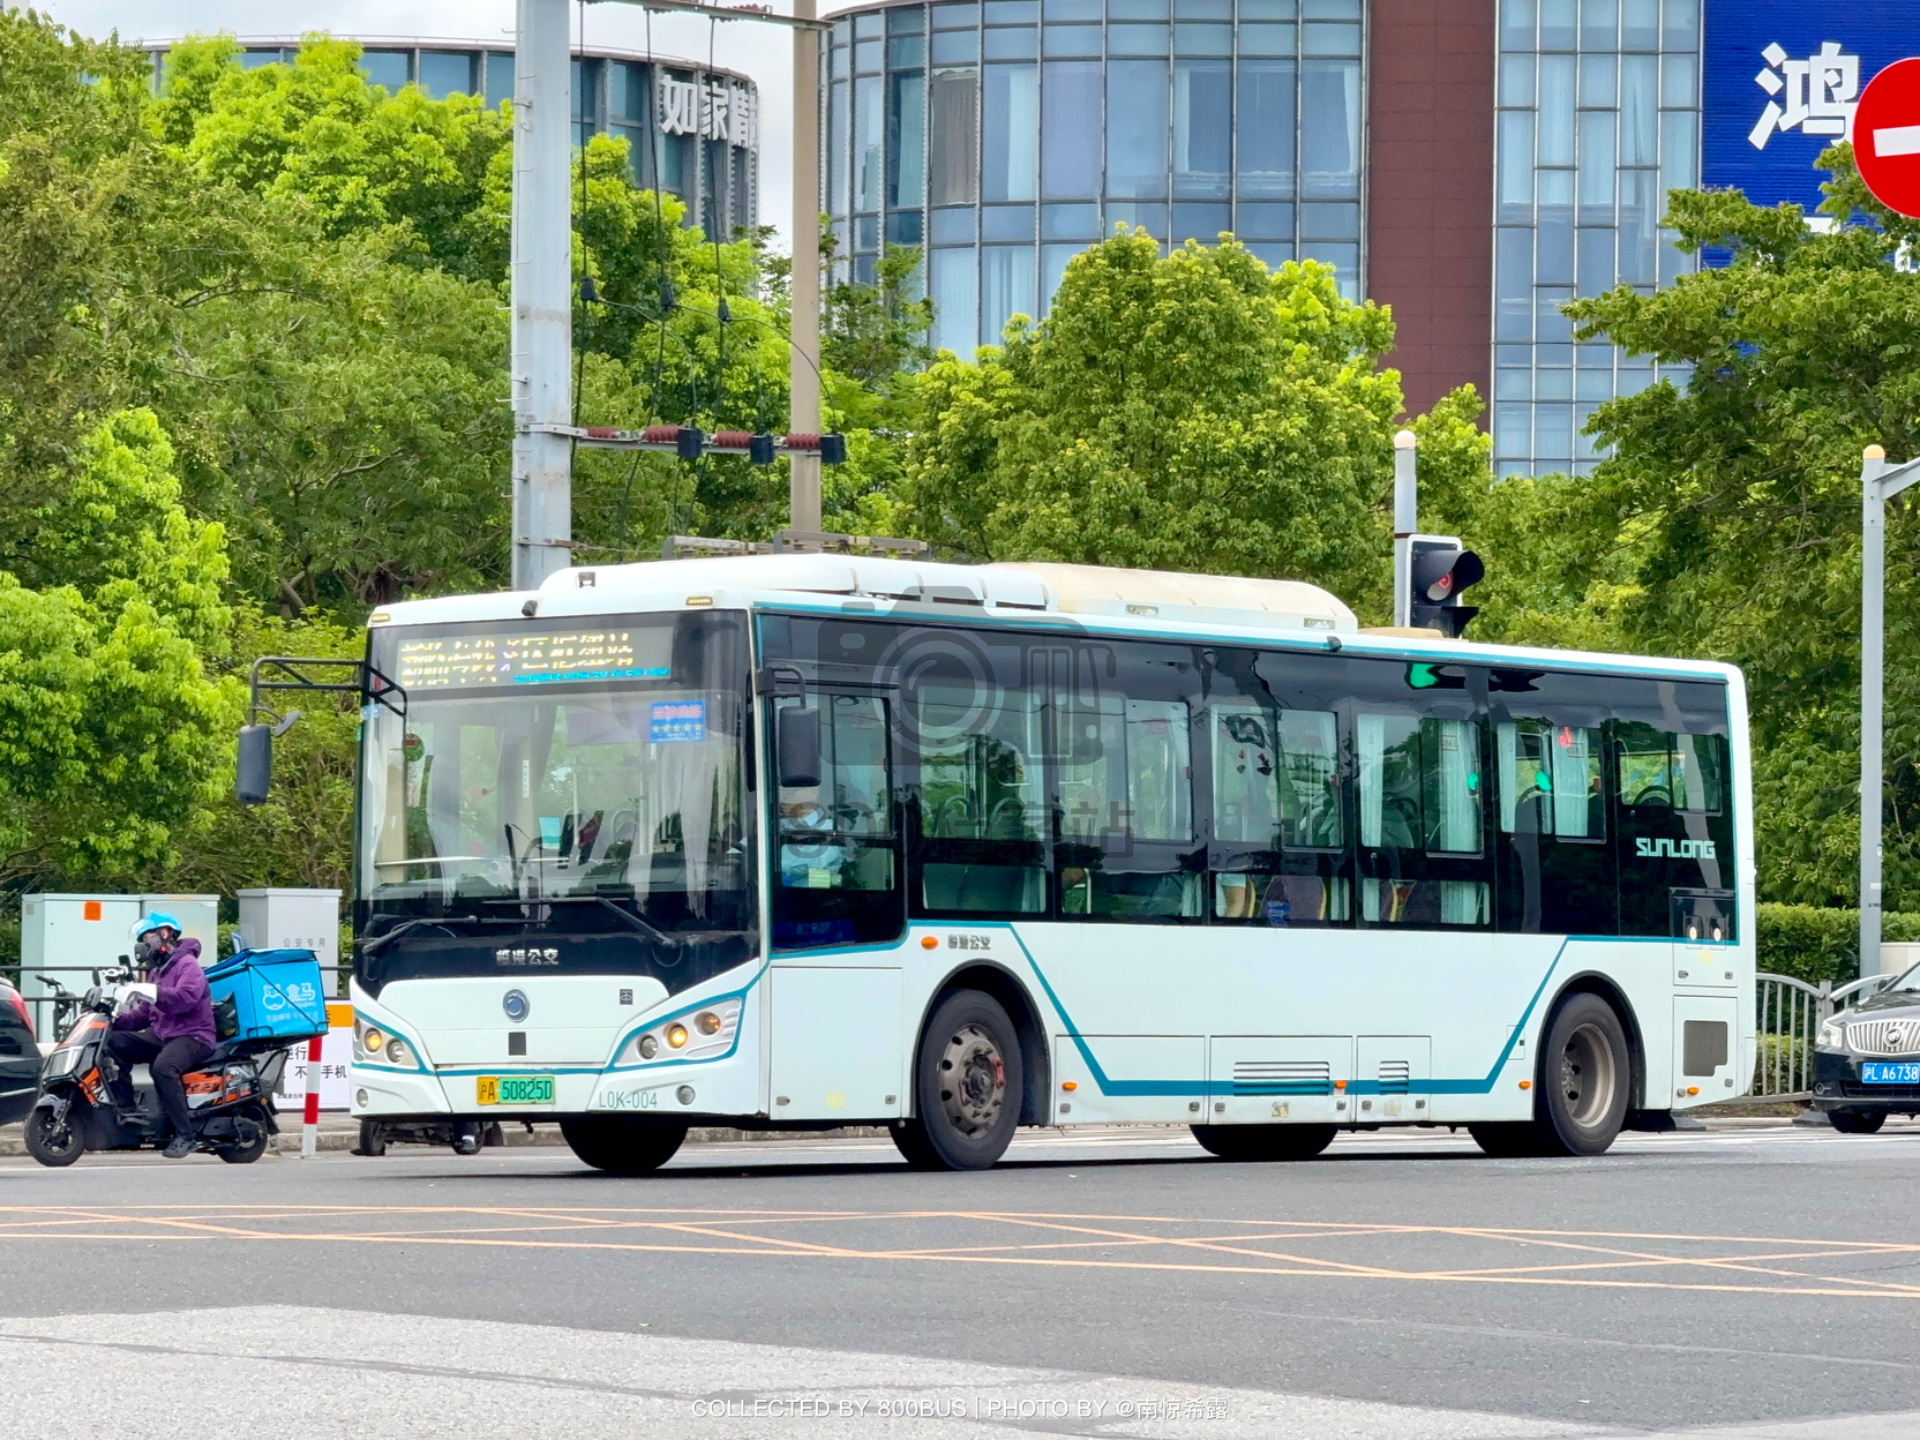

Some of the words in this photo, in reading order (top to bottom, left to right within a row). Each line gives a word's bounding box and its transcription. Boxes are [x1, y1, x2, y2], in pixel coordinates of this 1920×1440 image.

[1635, 837, 1716, 859] SUNLONG
[286, 983, 316, 1002] 盒马
[295, 1065, 347, 1079] 不手机
